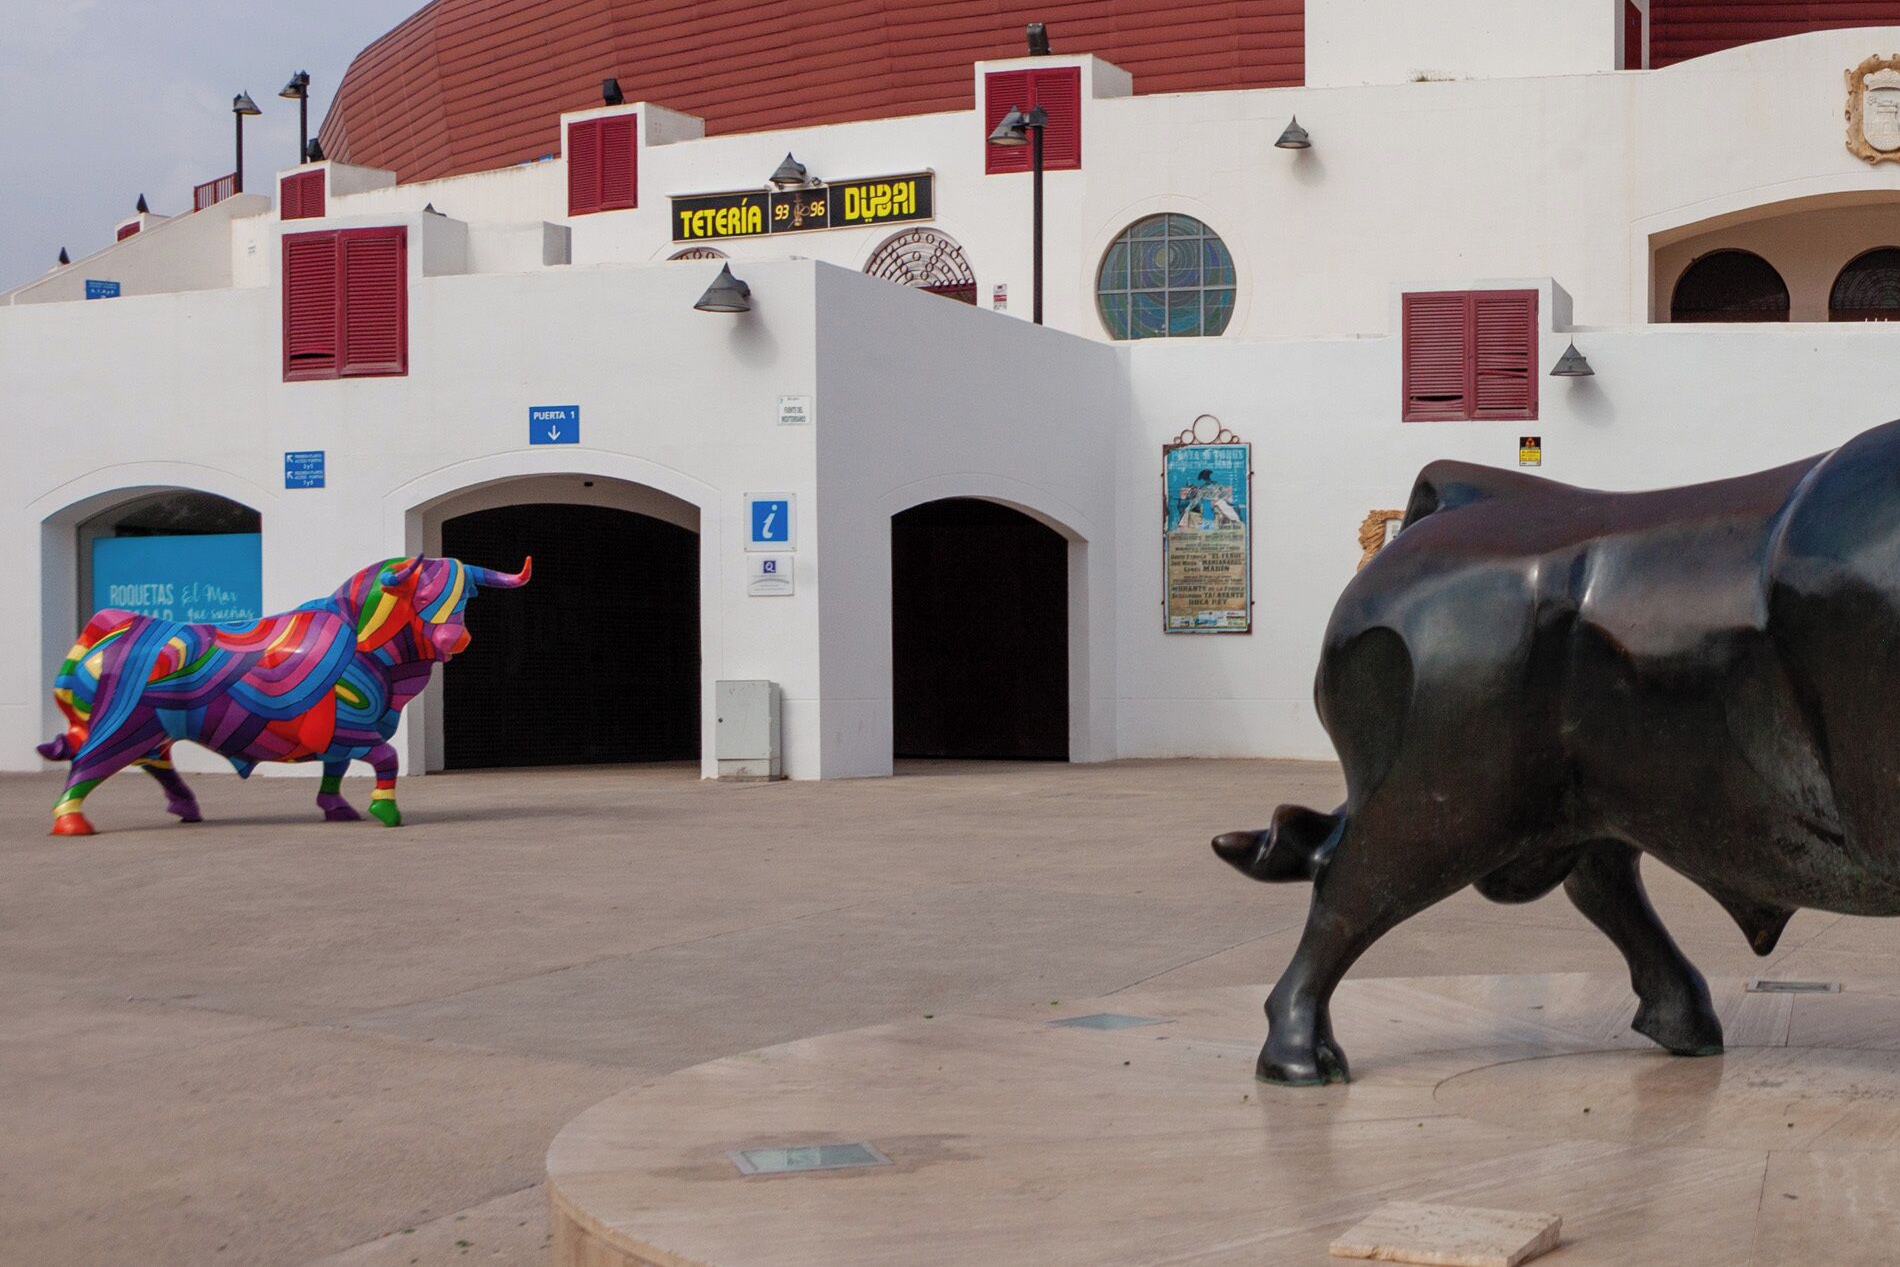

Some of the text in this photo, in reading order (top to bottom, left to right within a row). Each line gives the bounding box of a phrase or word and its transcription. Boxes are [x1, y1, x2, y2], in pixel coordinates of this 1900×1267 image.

[680, 181, 916, 238] TETERÍA 93 96 DUBAI
[533, 410, 575, 420] PUERTA 1
[110, 584, 174, 607] ROQUETAS
